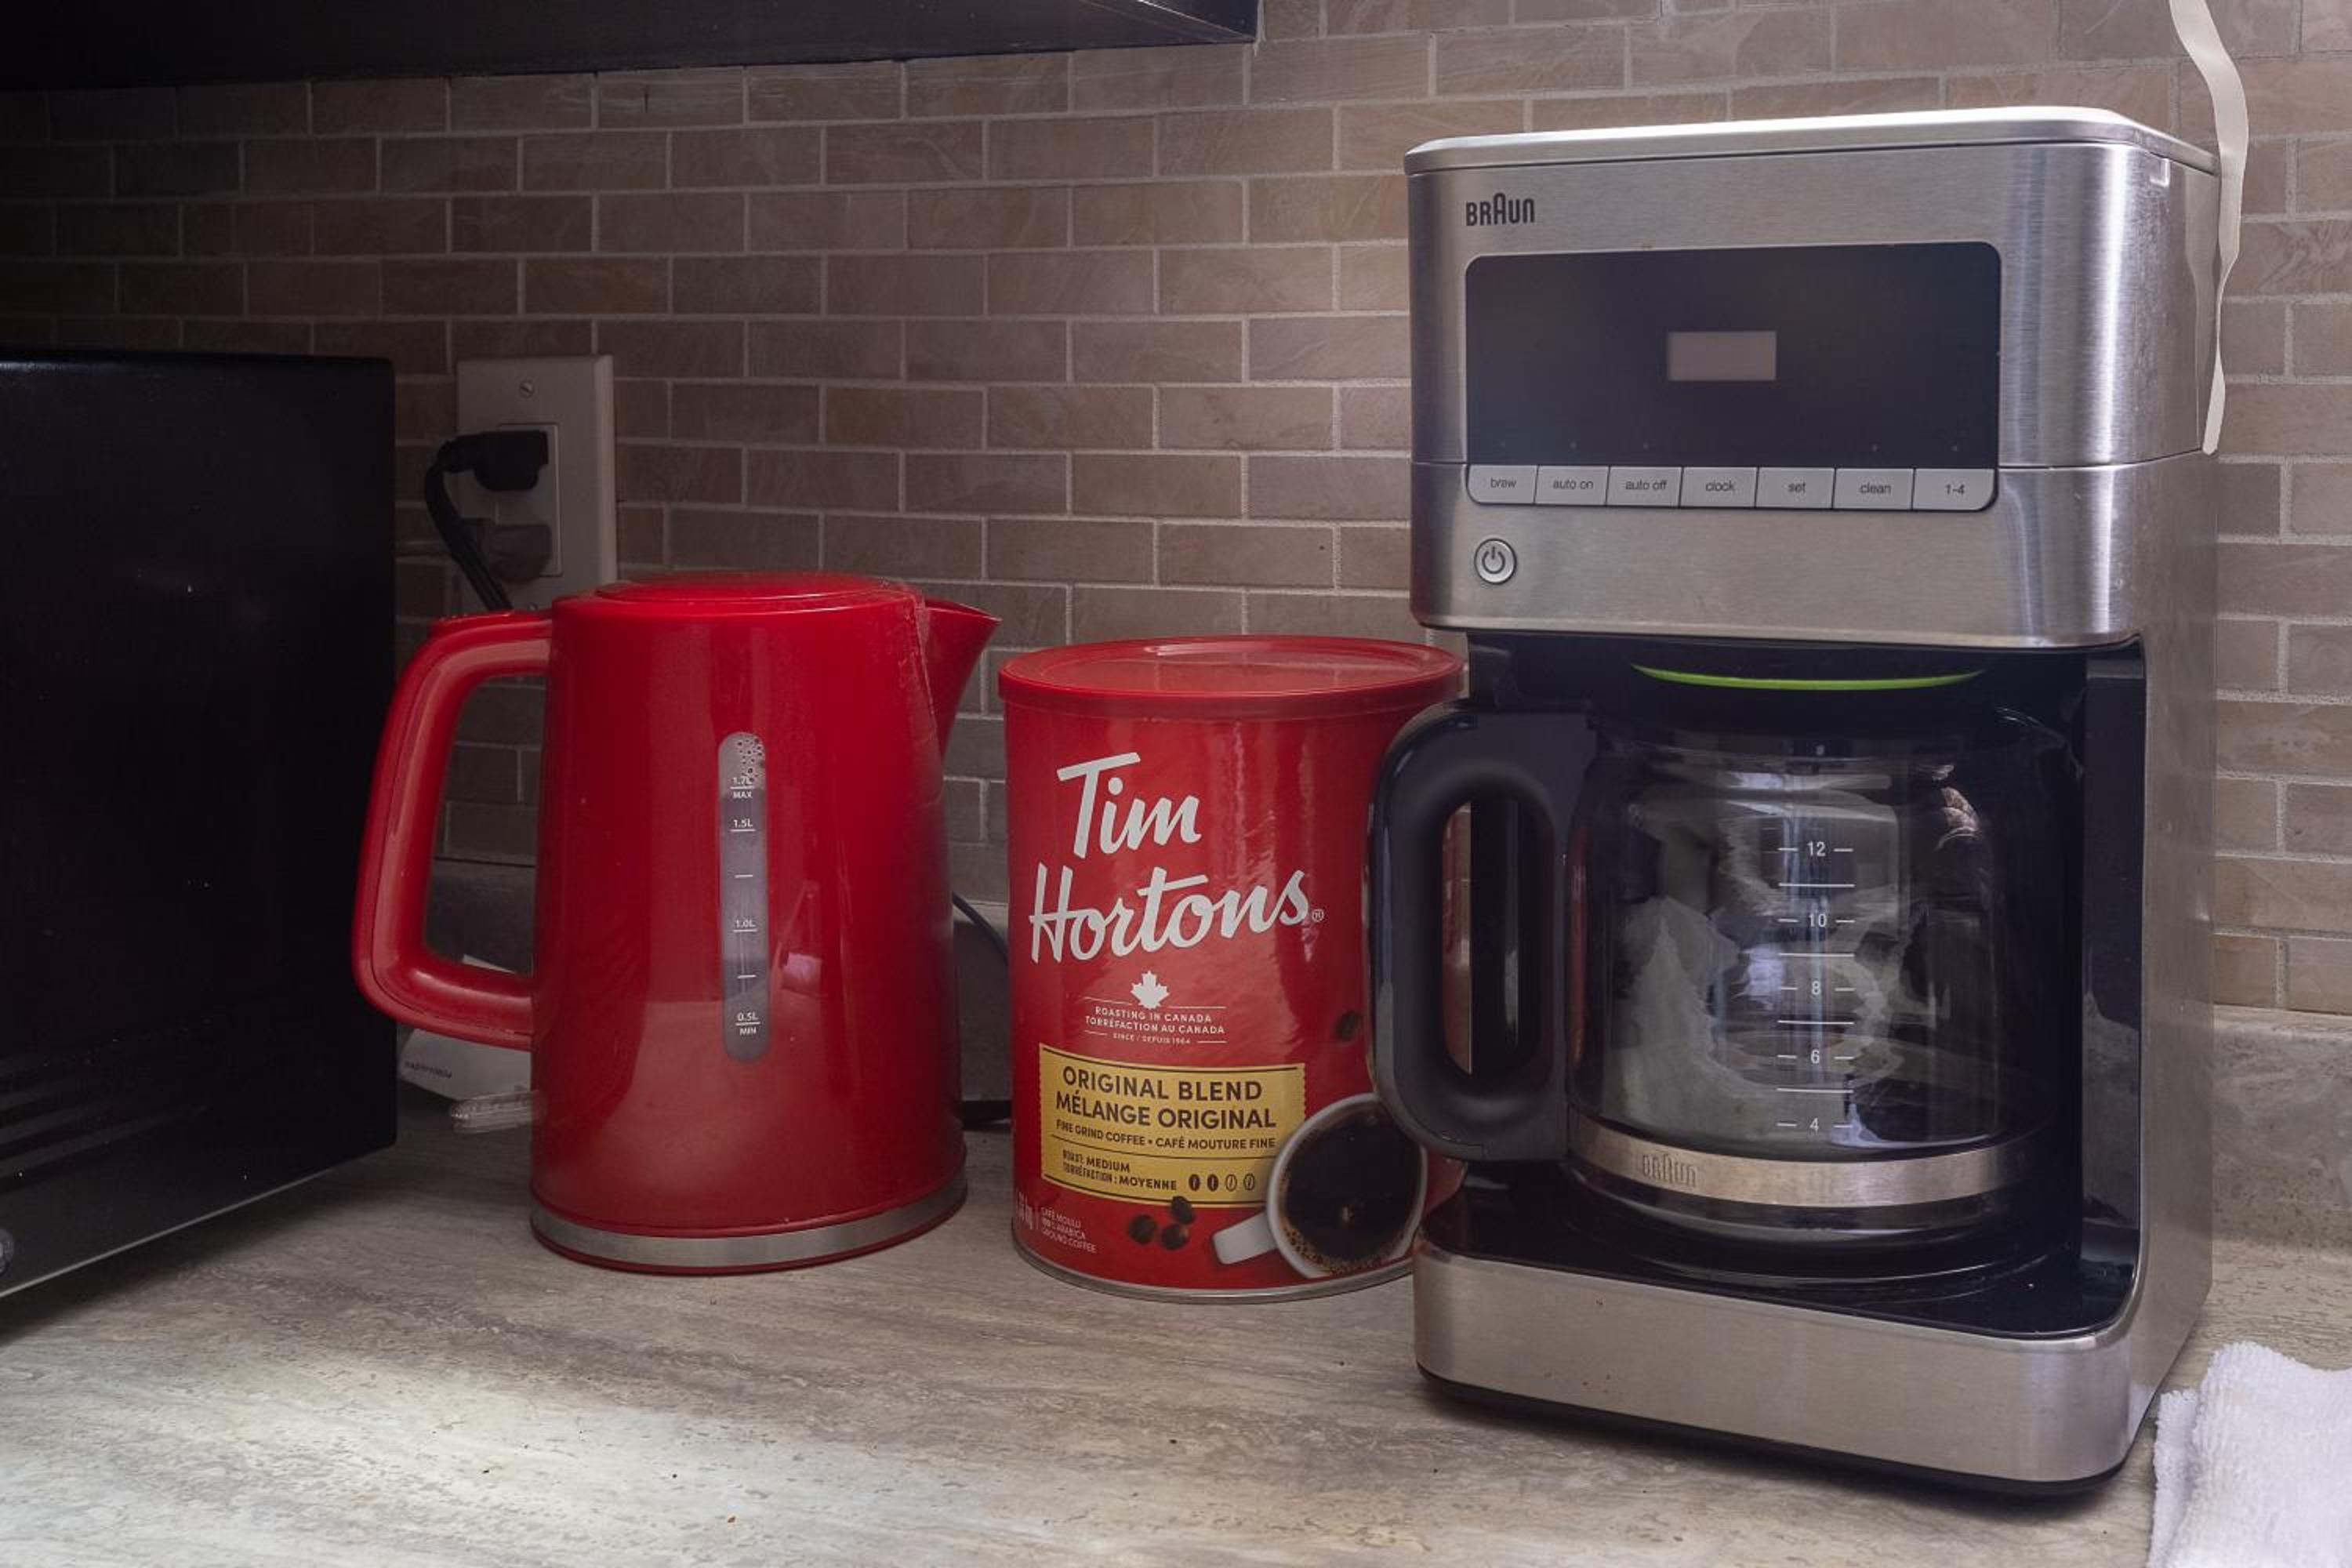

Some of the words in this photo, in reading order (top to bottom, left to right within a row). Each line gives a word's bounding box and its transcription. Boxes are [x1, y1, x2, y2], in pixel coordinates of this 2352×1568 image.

[1490, 477, 1517, 488] brew
[1552, 479, 1576, 490] auto
[1579, 480, 1595, 490] on
[1625, 480, 1650, 491] auto
[1652, 479, 1668, 491] off
[1705, 481, 1735, 492] clock
[1788, 482, 1806, 493] set
[1859, 483, 1892, 495] clean
[1945, 484, 1965, 495] 1-4
[1056, 752, 1202, 858] Tim
[733, 818, 753, 828] 1.5L
[1806, 841, 1827, 858] 12
[1808, 913, 1828, 928] 10
[1811, 981, 1822, 996] 8
[737, 1011, 760, 1022] 0.5L
[1094, 1006, 1146, 1021] ROASTING
[1149, 1012, 1161, 1022] IN
[1164, 1013, 1212, 1024] CANADA
[739, 1027, 757, 1036] MIN
[1160, 1025, 1176, 1034] AU
[1178, 1025, 1225, 1035] CANADA
[1810, 1050, 1820, 1065] 6
[1062, 1065, 1169, 1099] ORIGINAL
[1178, 1080, 1262, 1102] BLEND
[1056, 1090, 1151, 1126] MÉLANGE
[1157, 1108, 1277, 1130] ORIGINAL
[1809, 1117, 1820, 1132] 4
[1056, 1118, 1073, 1133] FINE
[1075, 1124, 1104, 1141] GRIND
[1105, 1131, 1146, 1146] COFFEE
[1155, 1135, 1185, 1149] CAFÉ
[1188, 1138, 1247, 1150] MOUTURE
[1249, 1138, 1276, 1149] FINE
[1086, 1155, 1131, 1173] MEDIUM
[1119, 1174, 1178, 1191] MOYENNE
